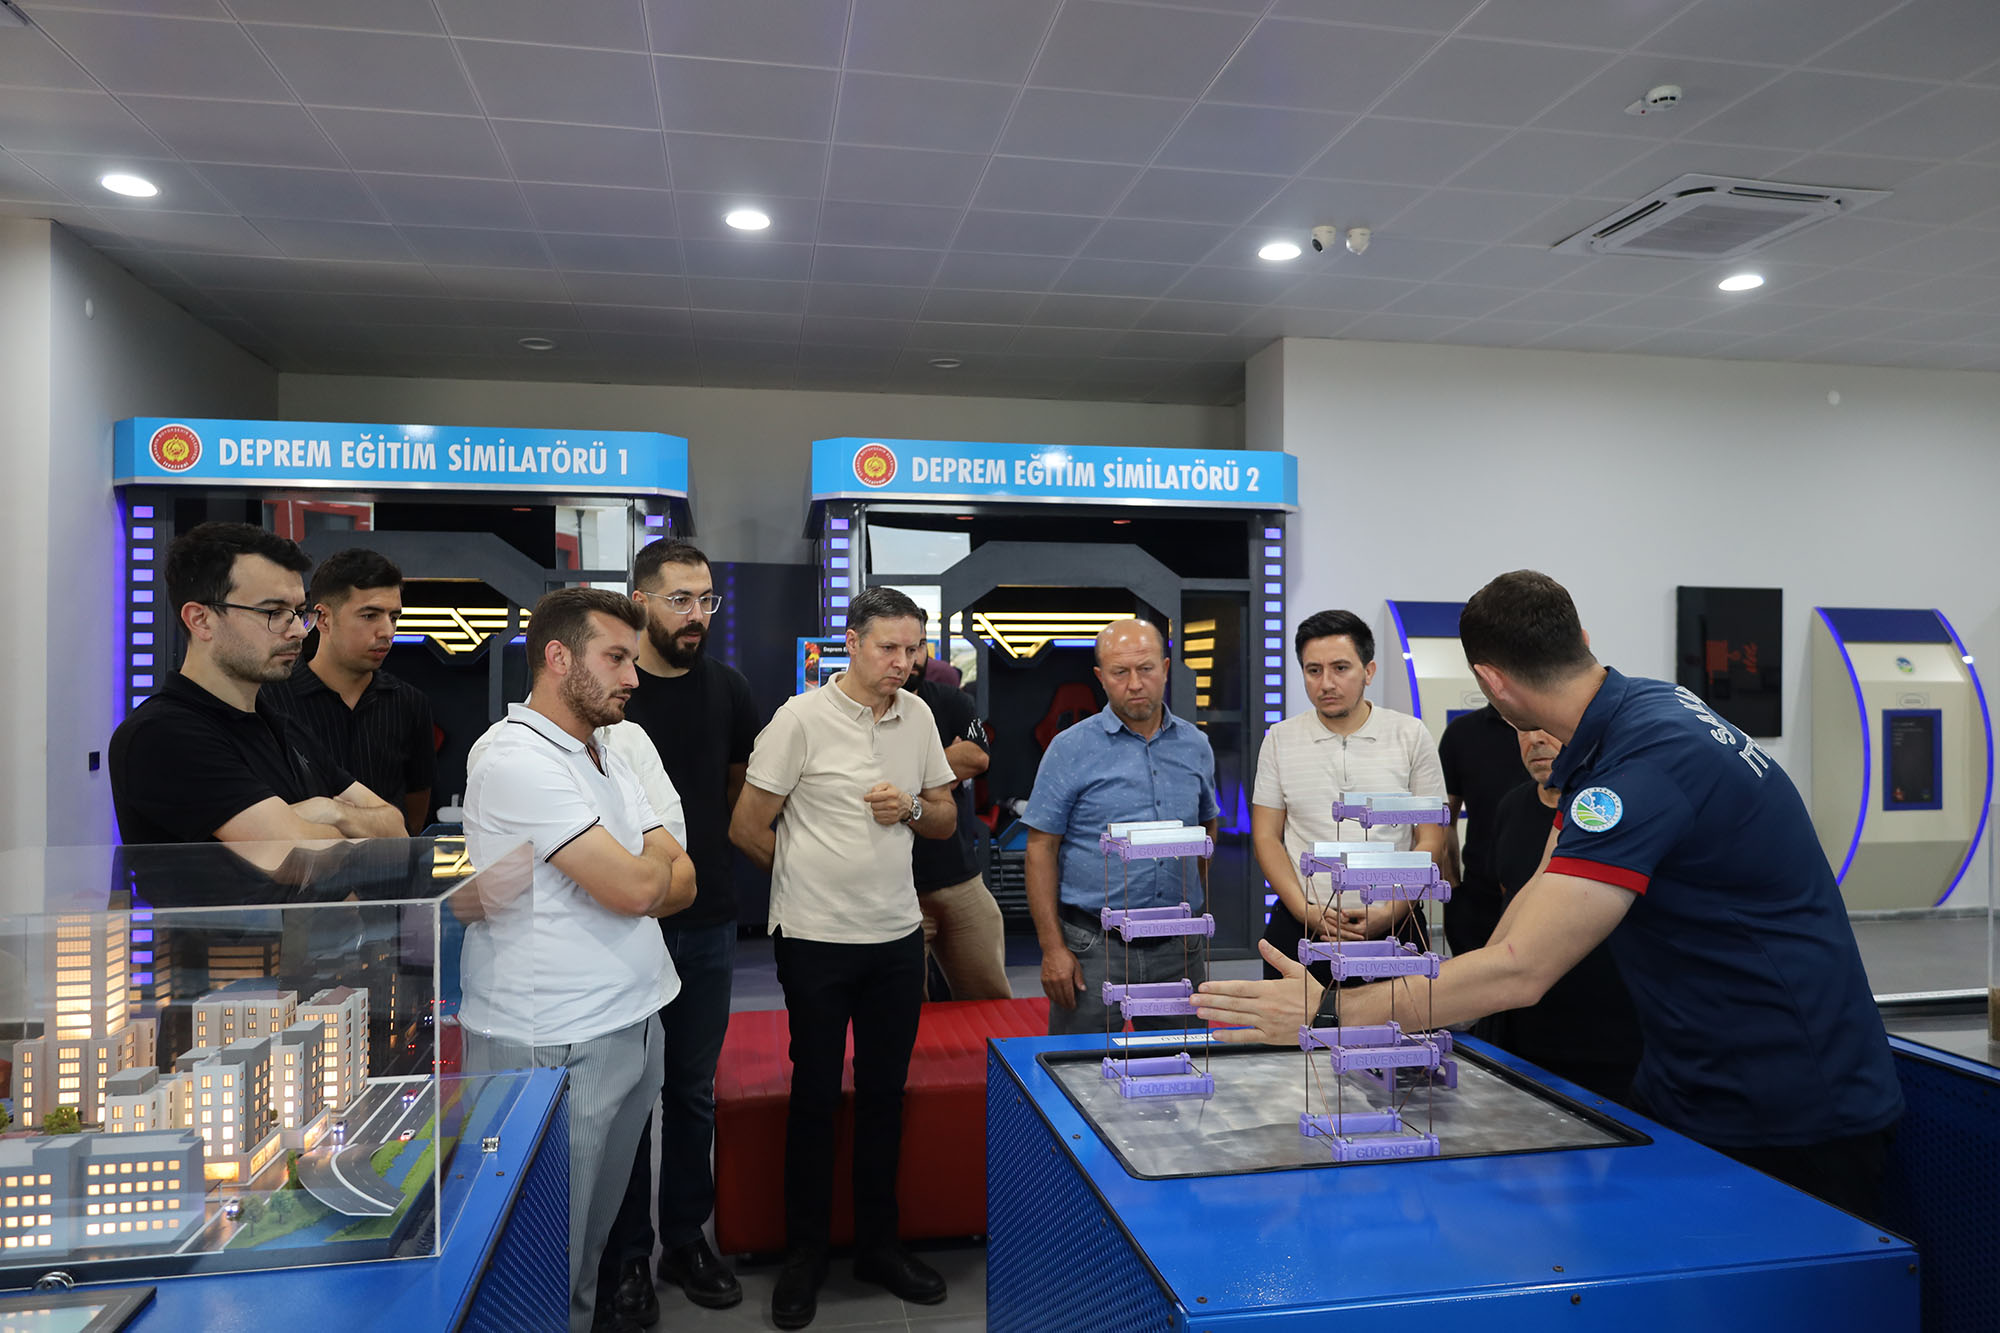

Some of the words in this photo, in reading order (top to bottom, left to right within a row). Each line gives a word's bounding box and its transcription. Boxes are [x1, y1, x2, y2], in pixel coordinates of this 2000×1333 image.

[219, 438, 331, 468] DEPREM
[341, 433, 437, 470] EĞİTİM
[448, 437, 607, 475] SİMİLATÖRÜ
[618, 449, 628, 475] 1
[912, 457, 1007, 484] DEPREM
[1103, 457, 1239, 491] SİMİLATÖRÜ
[1246, 467, 1260, 491] 2
